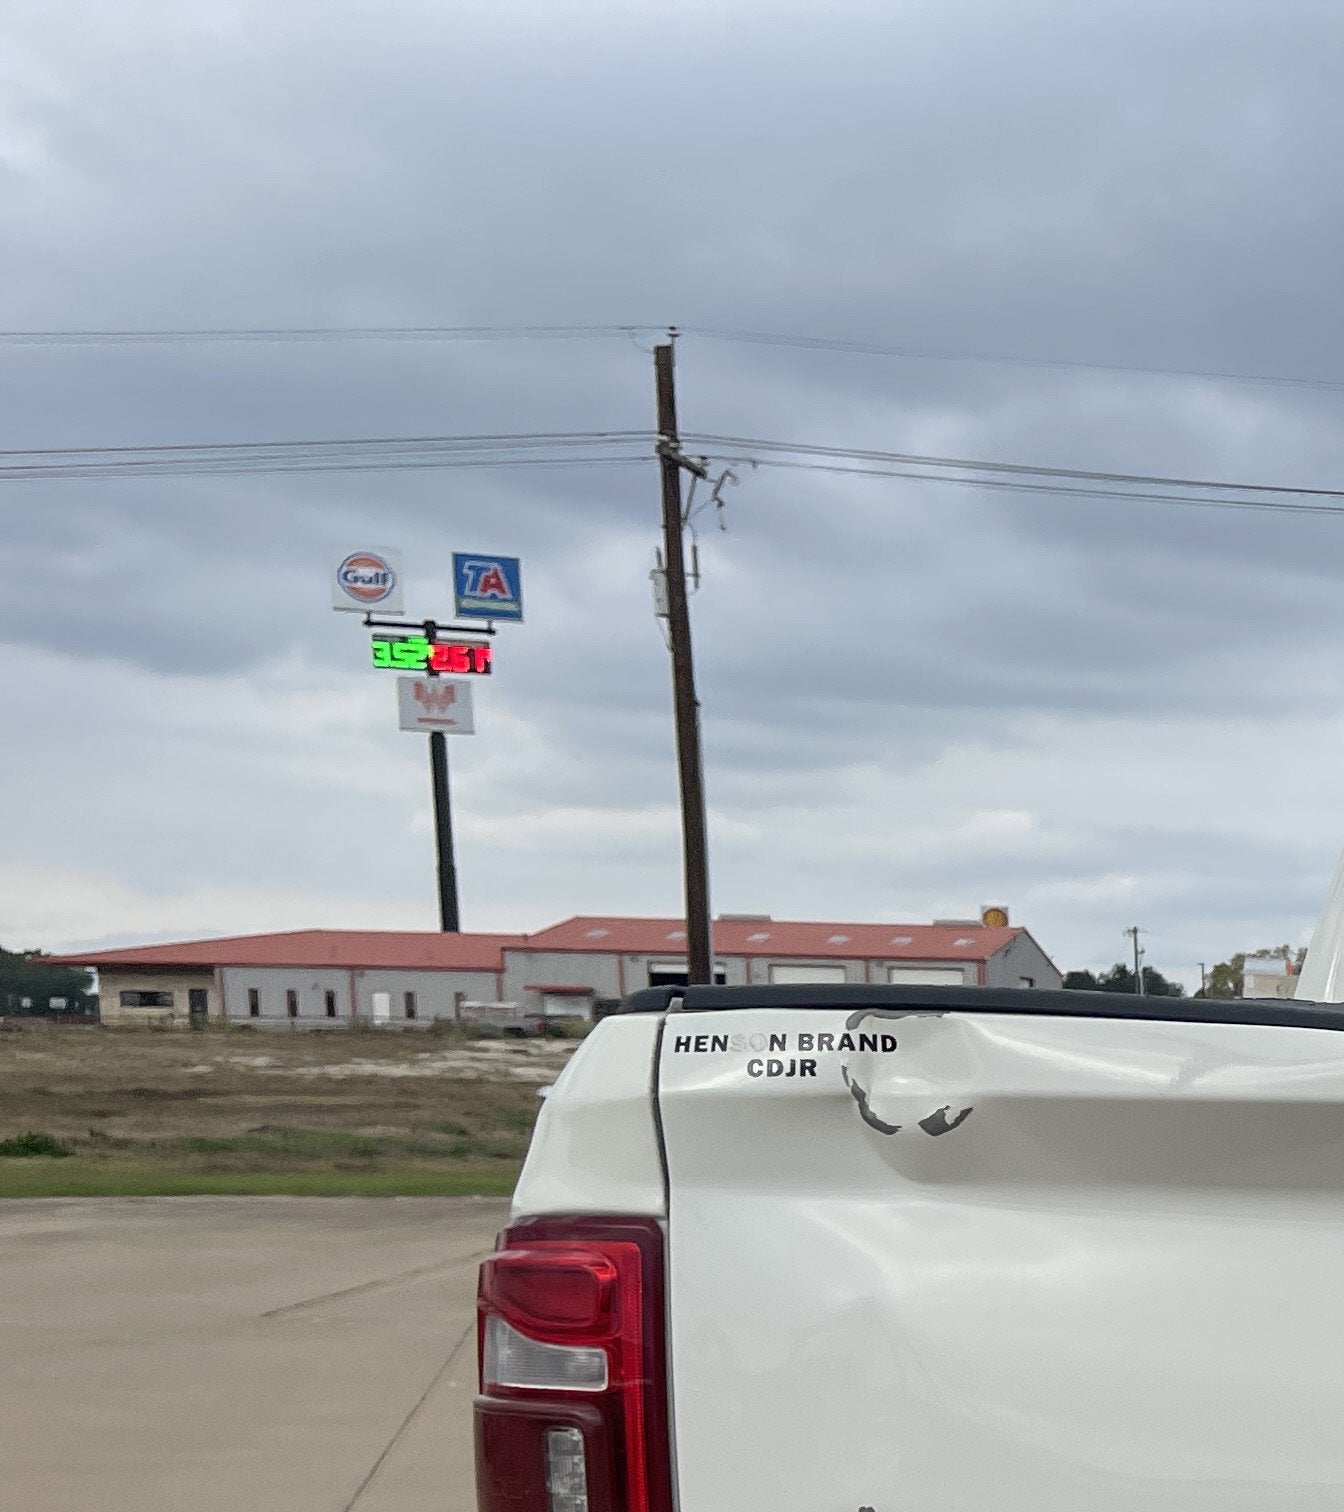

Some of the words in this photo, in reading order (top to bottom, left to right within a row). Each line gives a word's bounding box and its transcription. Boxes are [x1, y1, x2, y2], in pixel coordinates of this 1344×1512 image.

[342, 569, 390, 585] Gulf
[463, 561, 513, 599] TA
[798, 1033, 898, 1053] BRAND
[747, 1058, 817, 1077] CDJR
